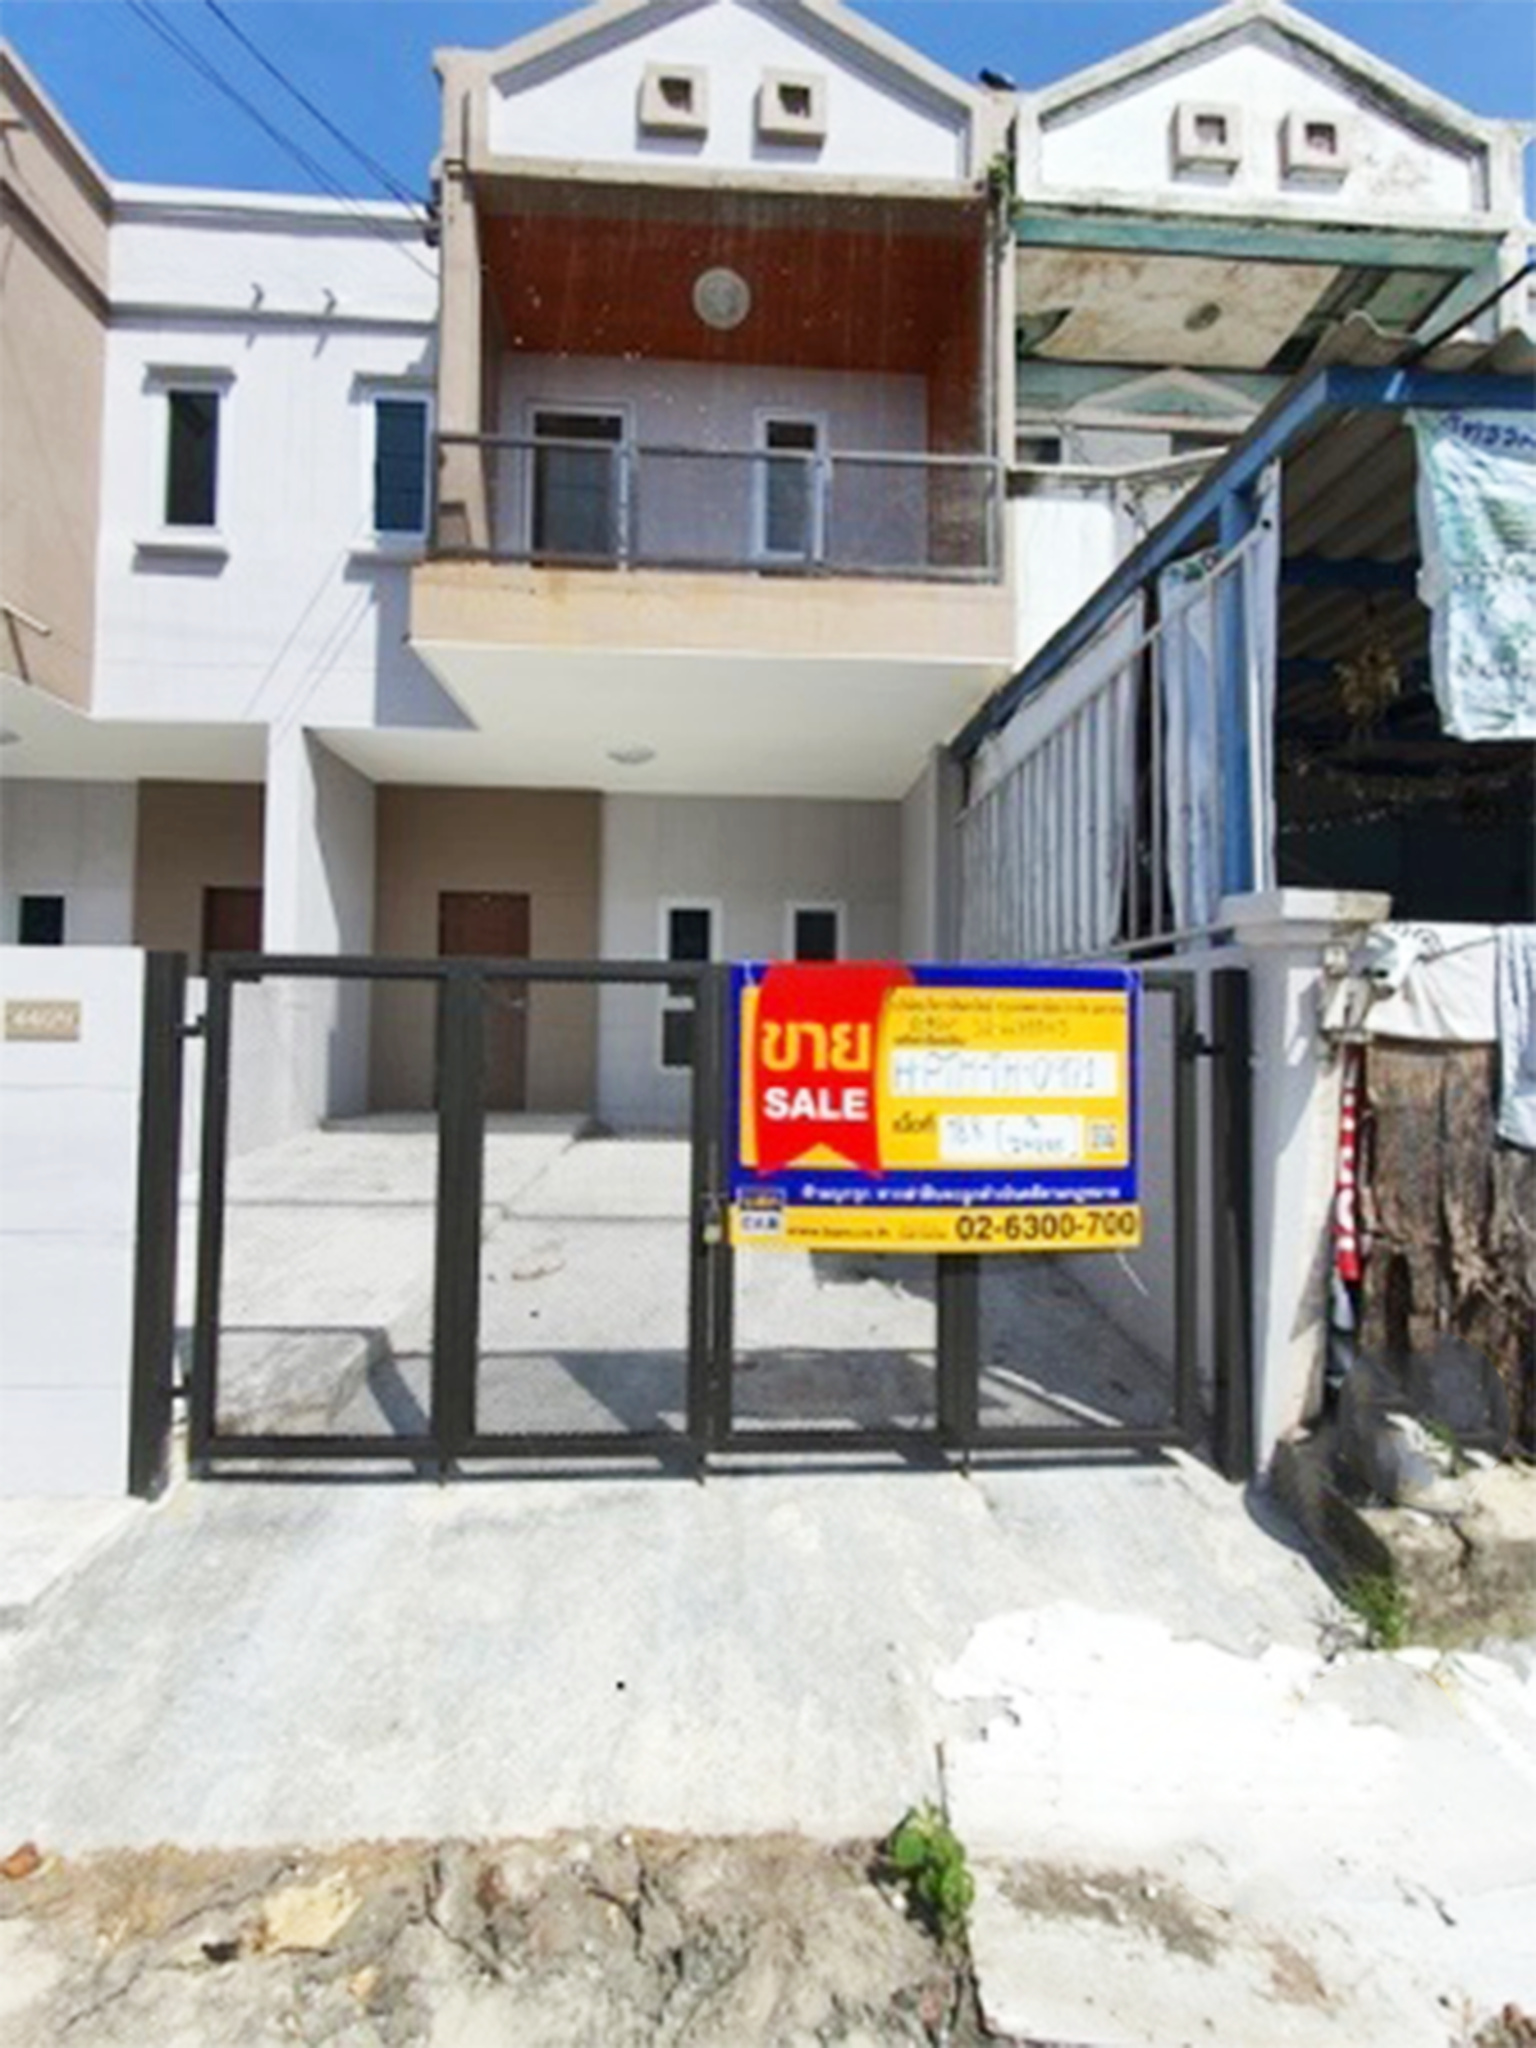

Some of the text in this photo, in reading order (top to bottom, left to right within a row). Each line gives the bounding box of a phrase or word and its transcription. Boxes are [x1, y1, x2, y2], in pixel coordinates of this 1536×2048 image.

[761, 1020, 870, 1070] ขาย
[764, 1086, 870, 1121] SALE
[955, 1209, 1137, 1242] 02-6300-700
